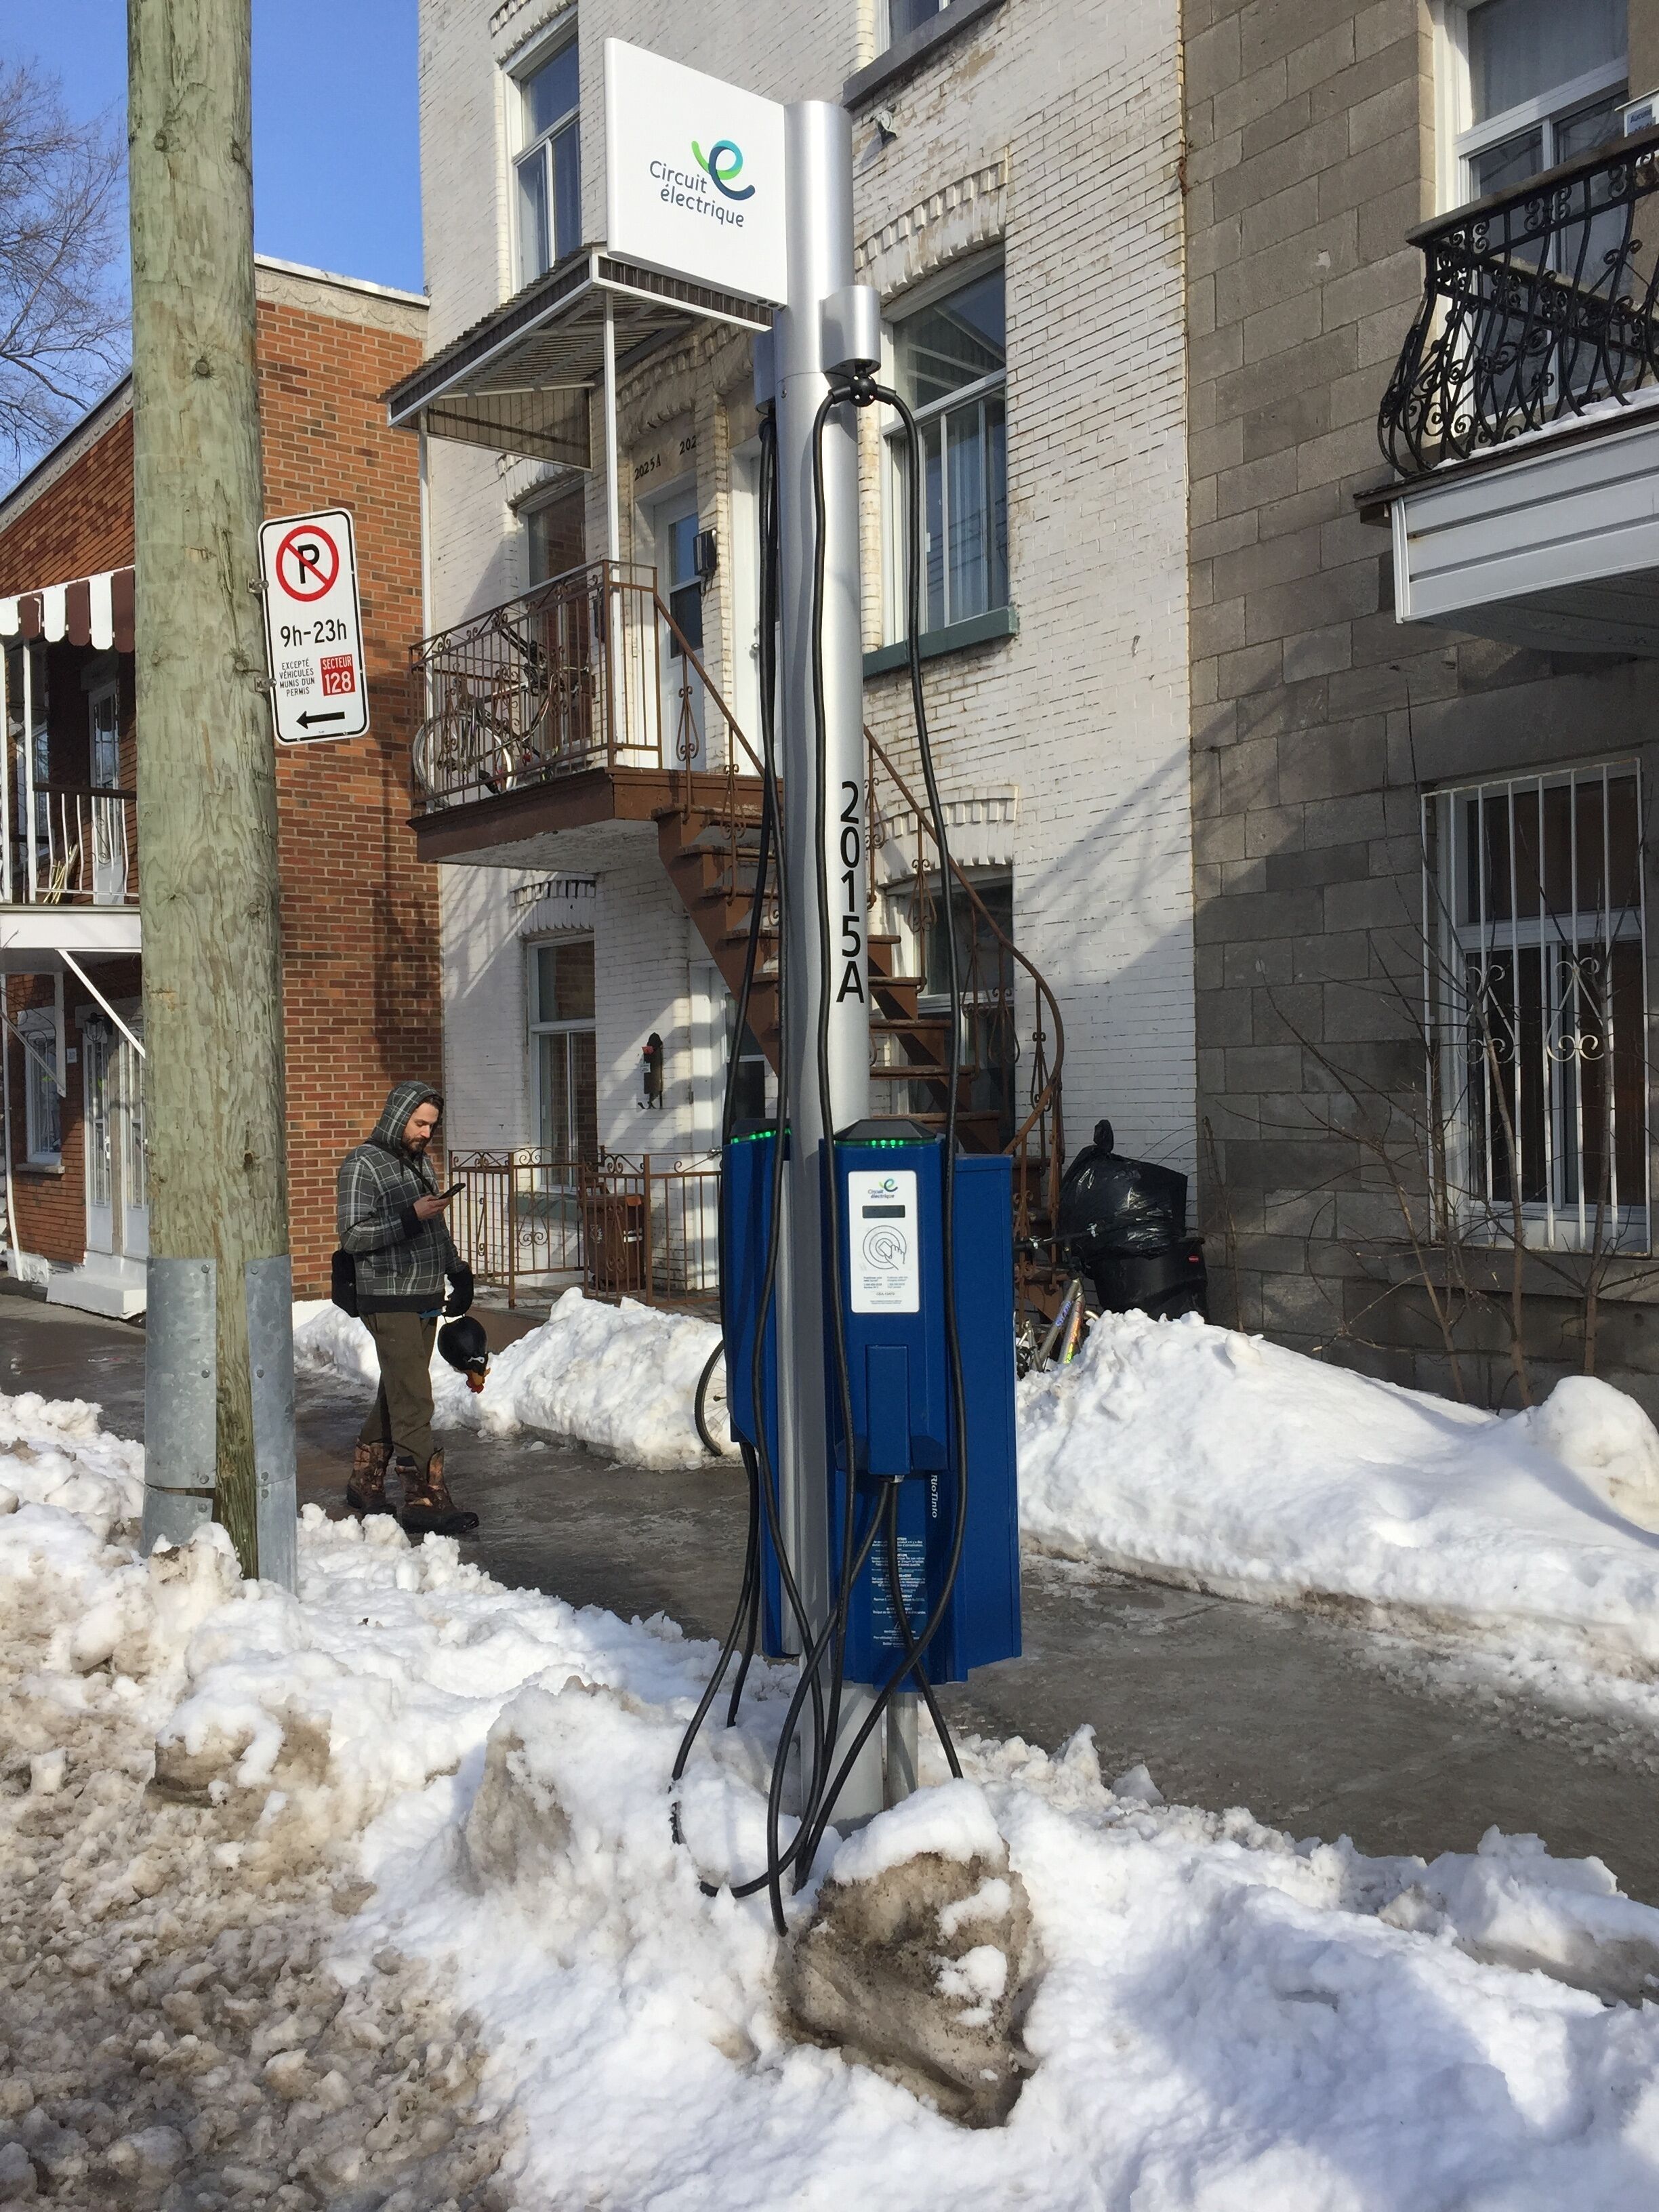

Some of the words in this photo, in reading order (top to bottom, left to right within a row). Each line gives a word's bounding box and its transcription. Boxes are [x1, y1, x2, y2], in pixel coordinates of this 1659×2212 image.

[649, 160, 708, 194] Circuit
[660, 183, 744, 228] électrique
[634, 453, 661, 482] 2025A
[280, 618, 347, 648] 9h-23h
[279, 668, 314, 679] VÉHICULES
[281, 657, 310, 670] EXCEPTÉ
[322, 655, 352, 670] SECTEUR
[279, 678, 300, 689] MUNIS
[286, 687, 310, 697] PERMIS
[325, 670, 352, 694] 128
[836, 780, 865, 1004] 2015A
